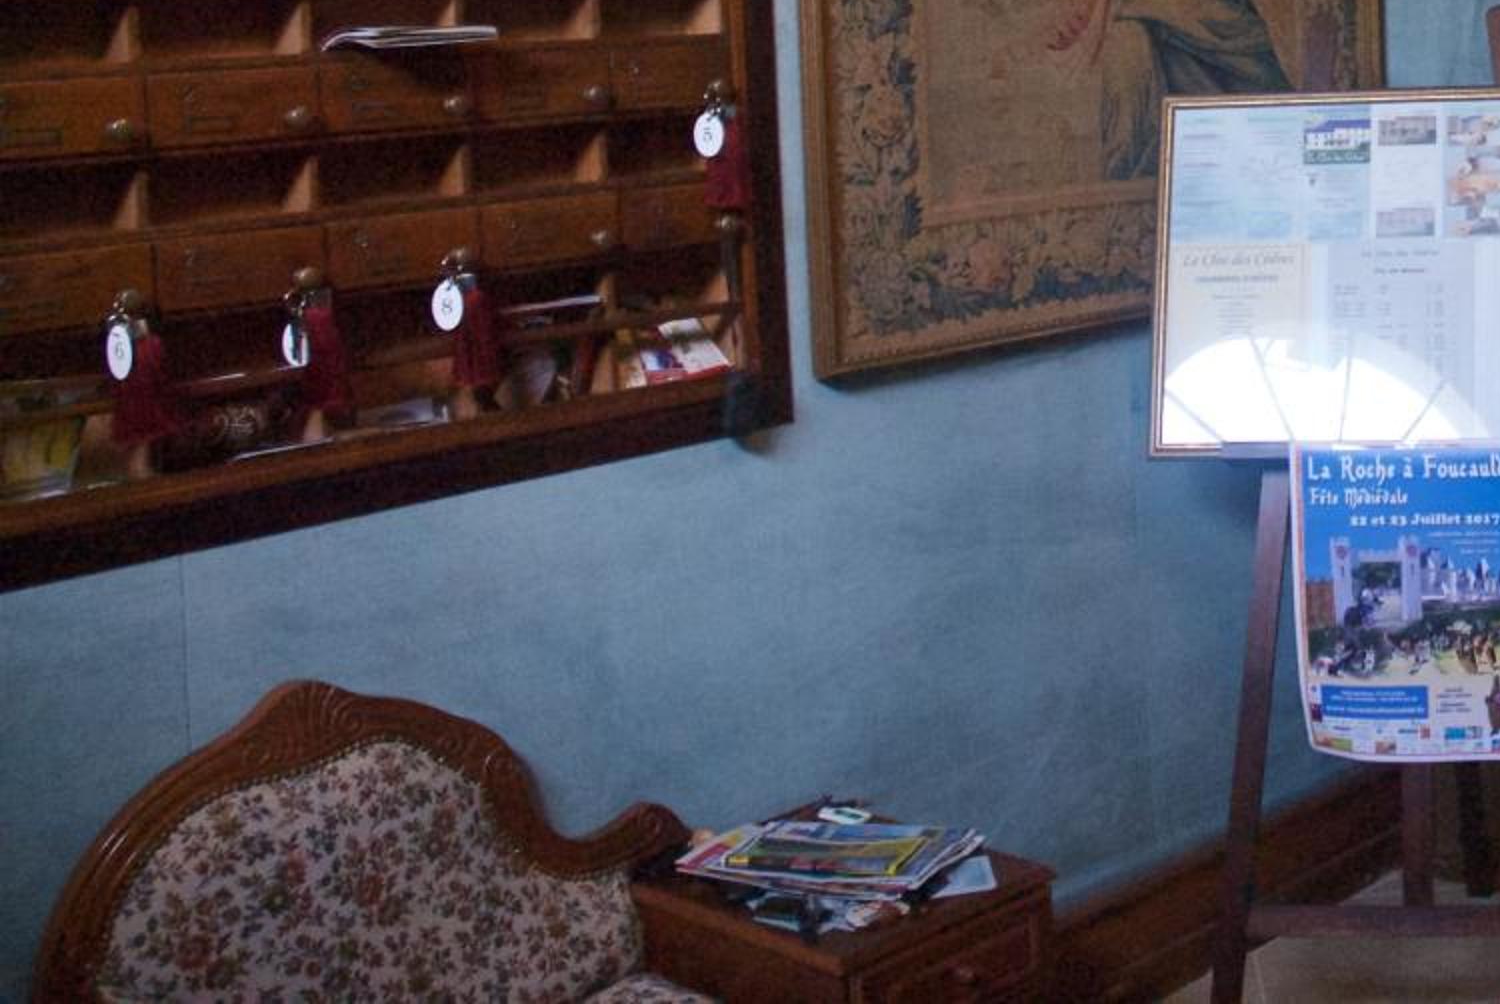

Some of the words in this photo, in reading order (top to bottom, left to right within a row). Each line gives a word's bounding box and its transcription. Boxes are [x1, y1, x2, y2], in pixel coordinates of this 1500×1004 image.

[1307, 455, 1331, 480] La
[1340, 454, 1396, 485] Roche
[1402, 457, 1414, 479] à
[1310, 487, 1339, 506] Fête
[1350, 515, 1367, 527] 22
[1372, 515, 1385, 526] et
[1388, 514, 1408, 527] 23
[1411, 512, 1460, 526] Juillet
[1465, 513, 1500, 526] 2017
